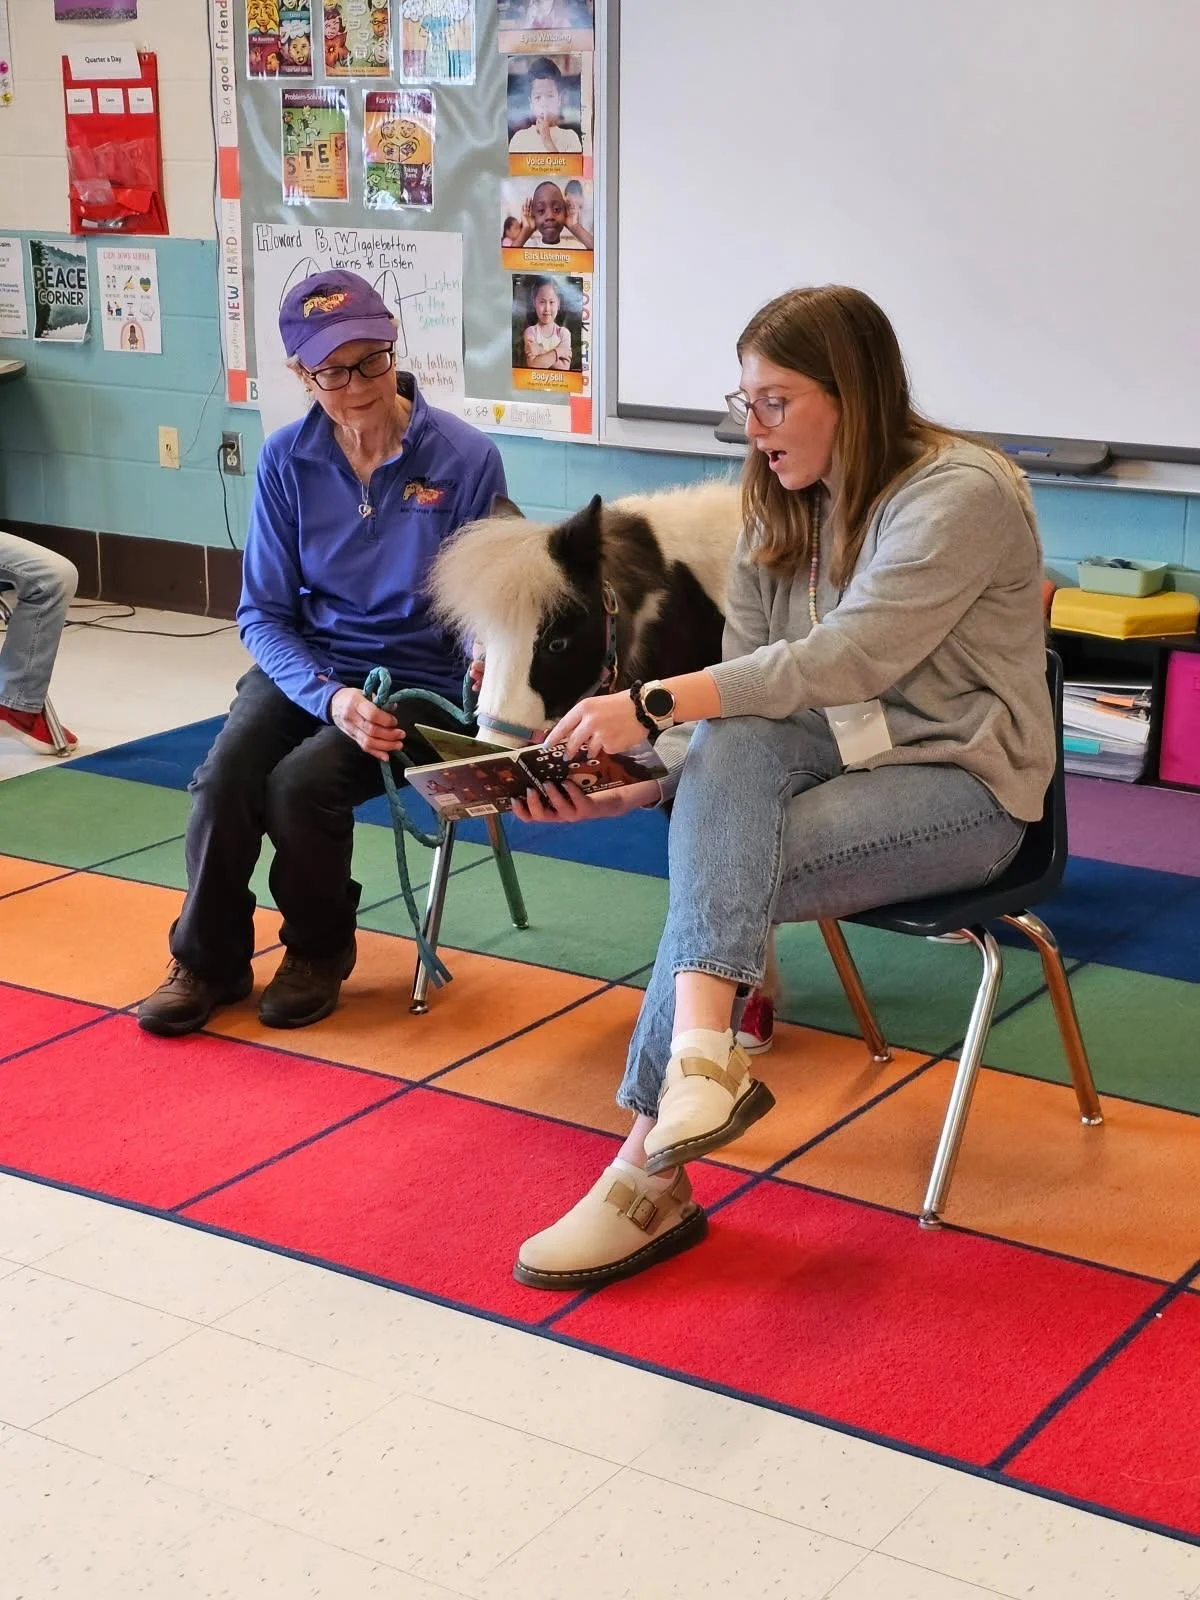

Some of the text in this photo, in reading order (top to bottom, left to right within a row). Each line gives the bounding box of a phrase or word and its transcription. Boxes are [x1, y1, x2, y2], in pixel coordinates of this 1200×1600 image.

[519, 32, 573, 43] Eyes Watching
[85, 56, 106, 64] Quarter
[111, 56, 122, 64] Day
[217, 56, 233, 91] good
[221, 109, 232, 124] Be
[526, 156, 567, 167] Voice Quiet
[256, 224, 303, 251] Howard
[333, 231, 417, 258] Wigglebottom
[226, 236, 238, 275] HARD
[329, 253, 414, 270] Learns to Listen
[523, 251, 571, 264] Ears Listening
[33, 266, 88, 290] PEACE
[38, 290, 85, 306] CORNER
[227, 285, 241, 321] NEW
[427, 353, 458, 371] talking
[531, 371, 550, 383] Body
